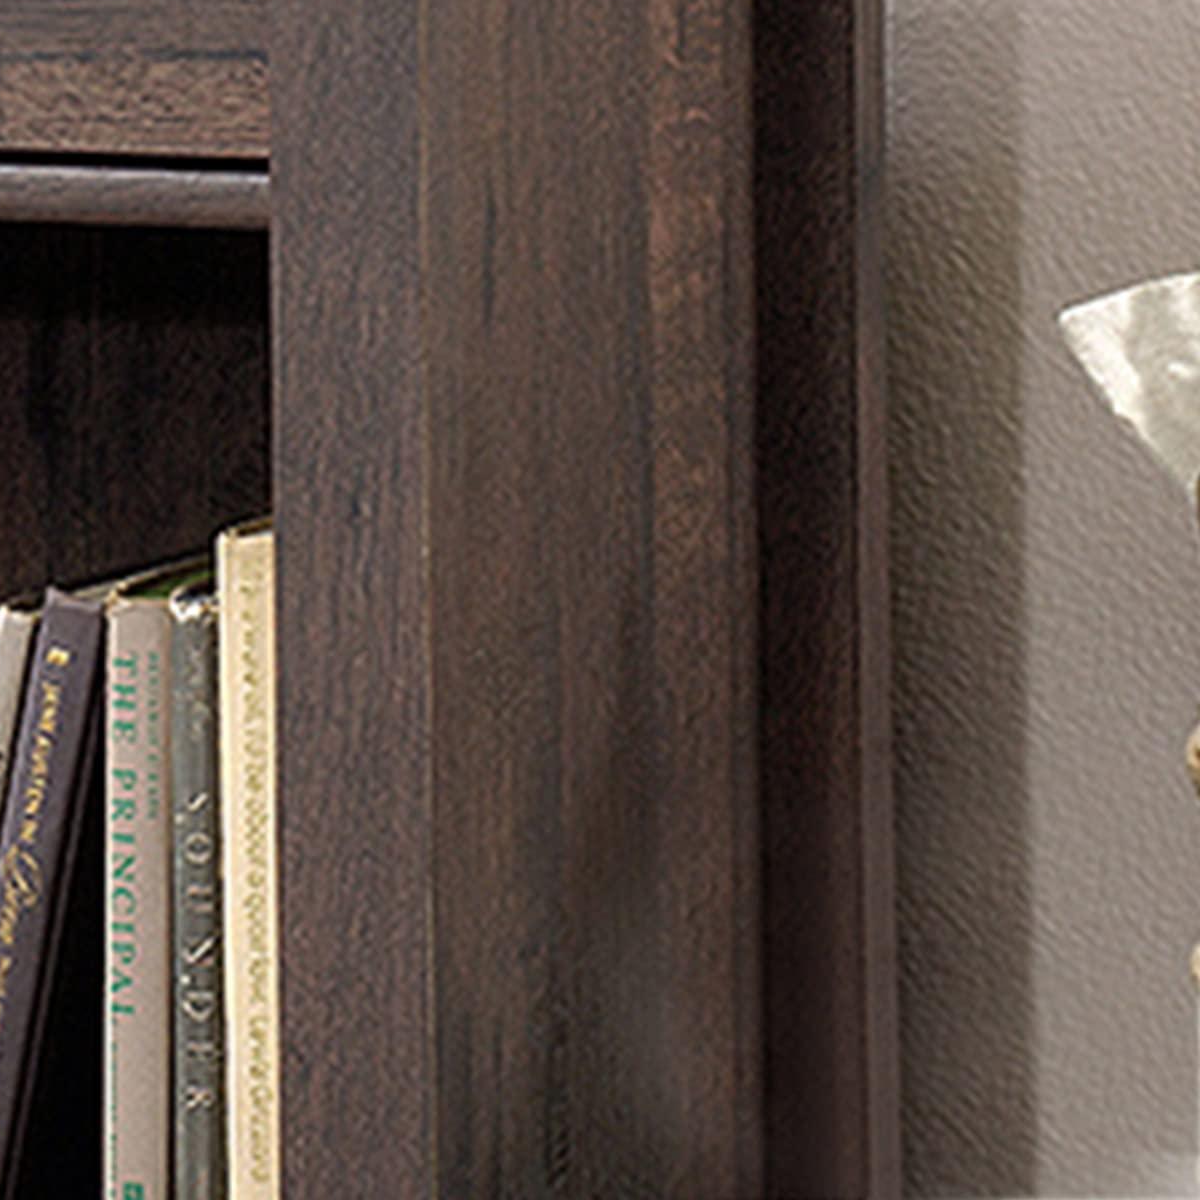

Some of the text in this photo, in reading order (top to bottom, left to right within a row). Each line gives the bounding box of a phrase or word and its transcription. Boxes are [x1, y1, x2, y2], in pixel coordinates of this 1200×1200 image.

[111, 652, 138, 1022] THE PRINCIPAL
[183, 791, 215, 1110] SOUNDER
